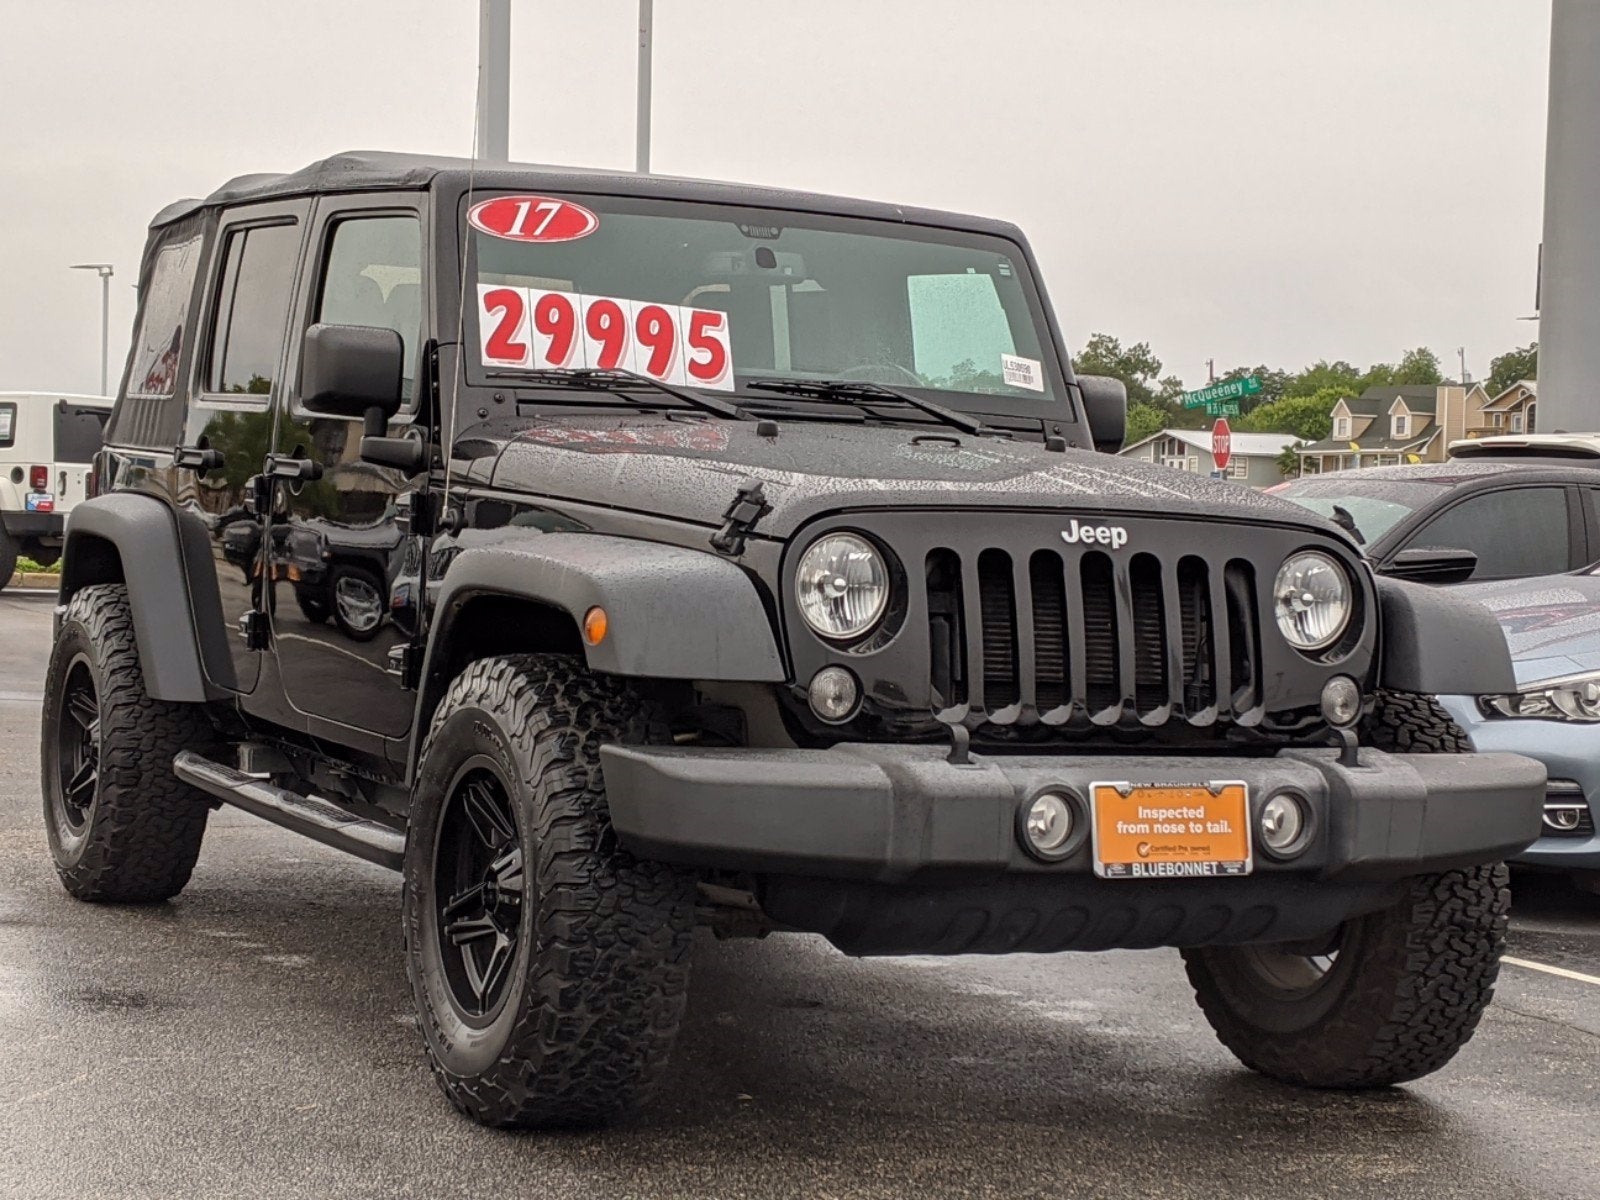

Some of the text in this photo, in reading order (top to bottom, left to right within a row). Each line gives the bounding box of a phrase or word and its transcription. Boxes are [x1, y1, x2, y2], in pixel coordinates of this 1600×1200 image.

[504, 201, 562, 236] 17
[483, 289, 727, 382] 29995
[1183, 382, 1243, 405] McQueeney
[1213, 435, 1229, 454] STOP
[1061, 519, 1128, 549] Jeep
[1138, 806, 1205, 821] Inspected
[1117, 821, 1232, 834] from nose to tail.
[1132, 861, 1219, 876] BLUEBONNET
